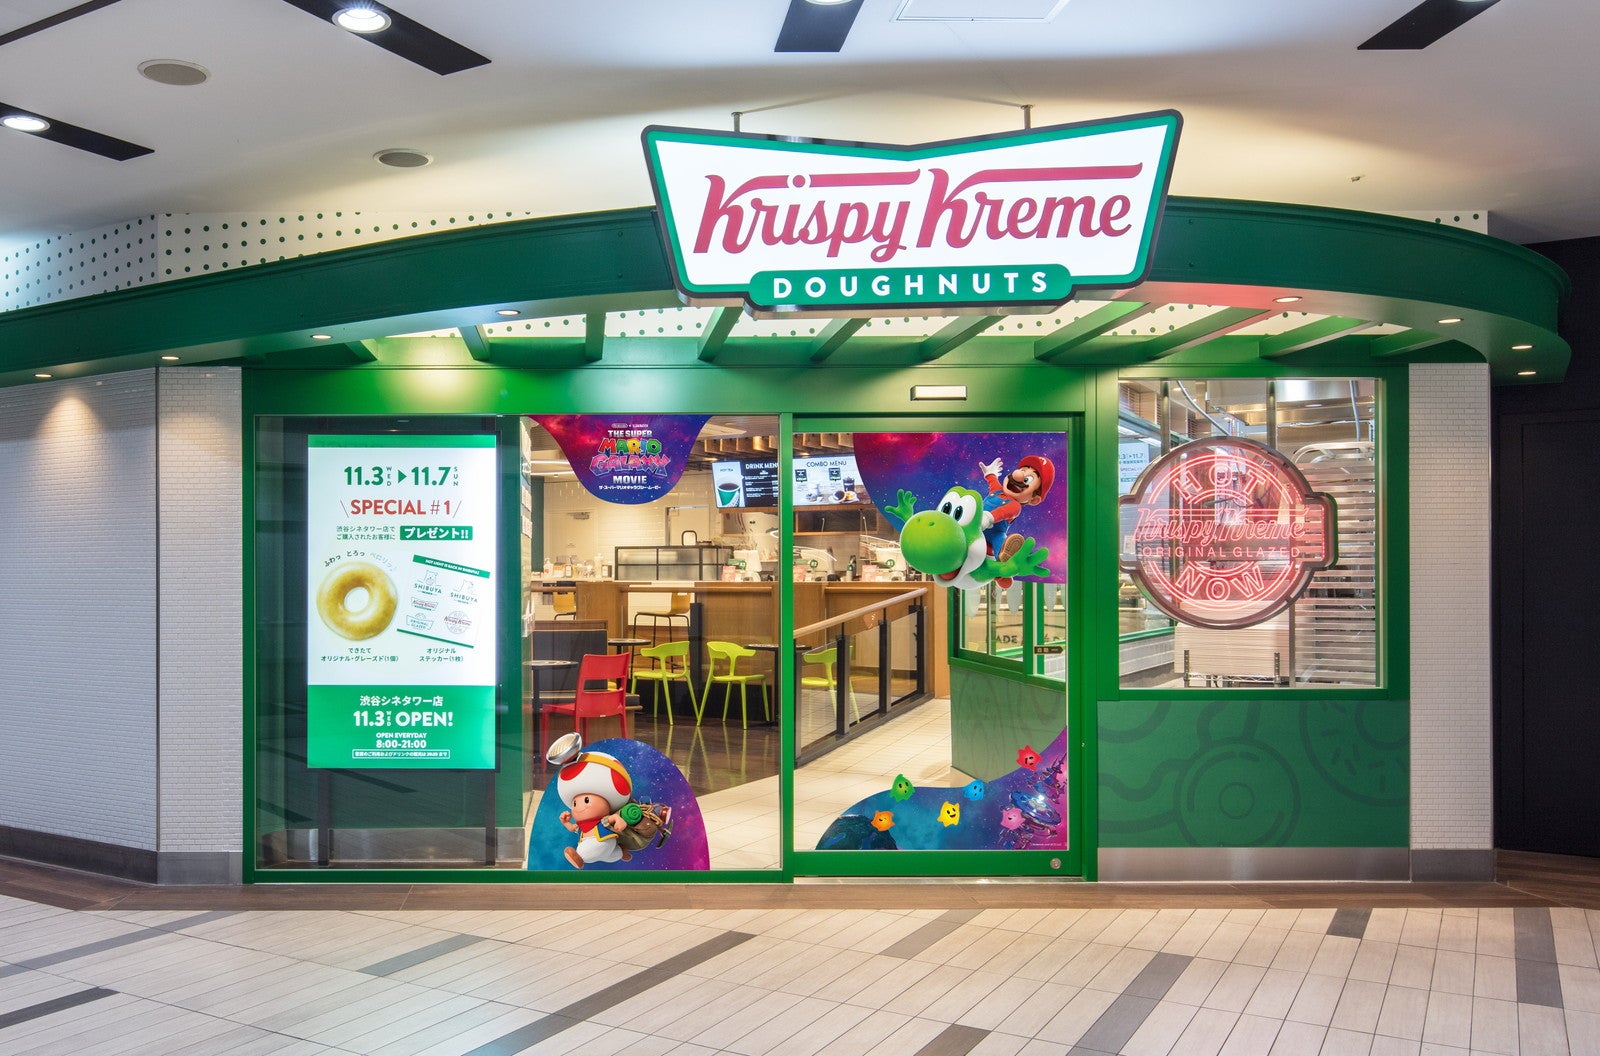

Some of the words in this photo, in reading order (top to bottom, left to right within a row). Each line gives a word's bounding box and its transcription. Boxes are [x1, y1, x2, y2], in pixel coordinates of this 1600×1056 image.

[693, 168, 920, 263] Krispy
[916, 162, 1143, 249] Kreme
[773, 272, 1047, 299] DOUGHNUTS
[608, 430, 624, 438] THE
[625, 430, 653, 438] SUPER
[598, 437, 662, 455] MARIO
[589, 454, 671, 477] GALAXY
[344, 466, 384, 486] 11.3
[411, 466, 451, 486] 11.7
[613, 475, 648, 484] MOVIE
[1172, 462, 1266, 501] HOT
[350, 499, 427, 515] SPECIAL
[1132, 507, 1222, 546] Krispy
[1218, 506, 1310, 543] Kreme
[1142, 546, 1226, 558] ORIGINAL
[1232, 546, 1300, 558] GLAZED
[414, 583, 442, 594] SHIBUYA
[1175, 565, 1265, 601] NOW
[450, 592, 478, 603] SHIBUYA
[996, 635, 1018, 644] ADE
[359, 695, 443, 707] 渋谷シネタワー店
[353, 710, 385, 727] 11.3
[395, 711, 453, 727] OPEN!
[375, 740, 427, 748] 8:00-21:00
